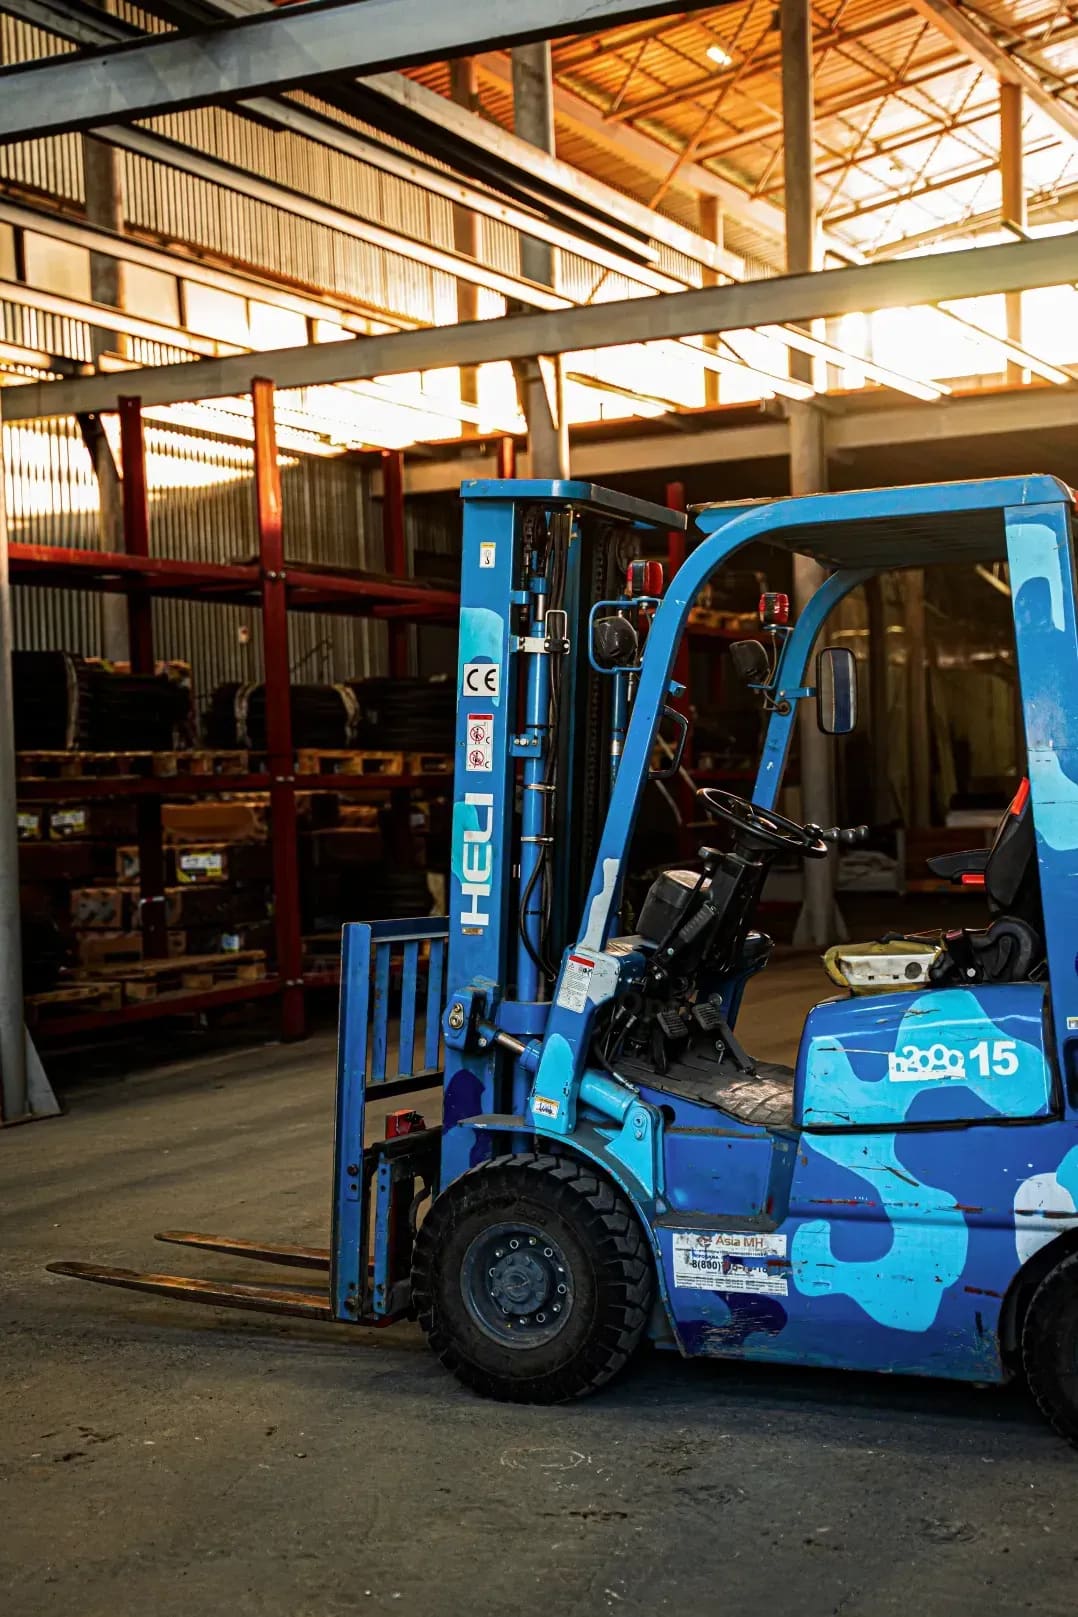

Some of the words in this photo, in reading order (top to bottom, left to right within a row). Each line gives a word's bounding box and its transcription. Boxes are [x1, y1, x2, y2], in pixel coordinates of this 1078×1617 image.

[466, 667, 497, 692] CE
[460, 792, 494, 926] HELI
[969, 1040, 1019, 1077] 15
[715, 1235, 741, 1248] Asia
[743, 1237, 764, 1248] MH
